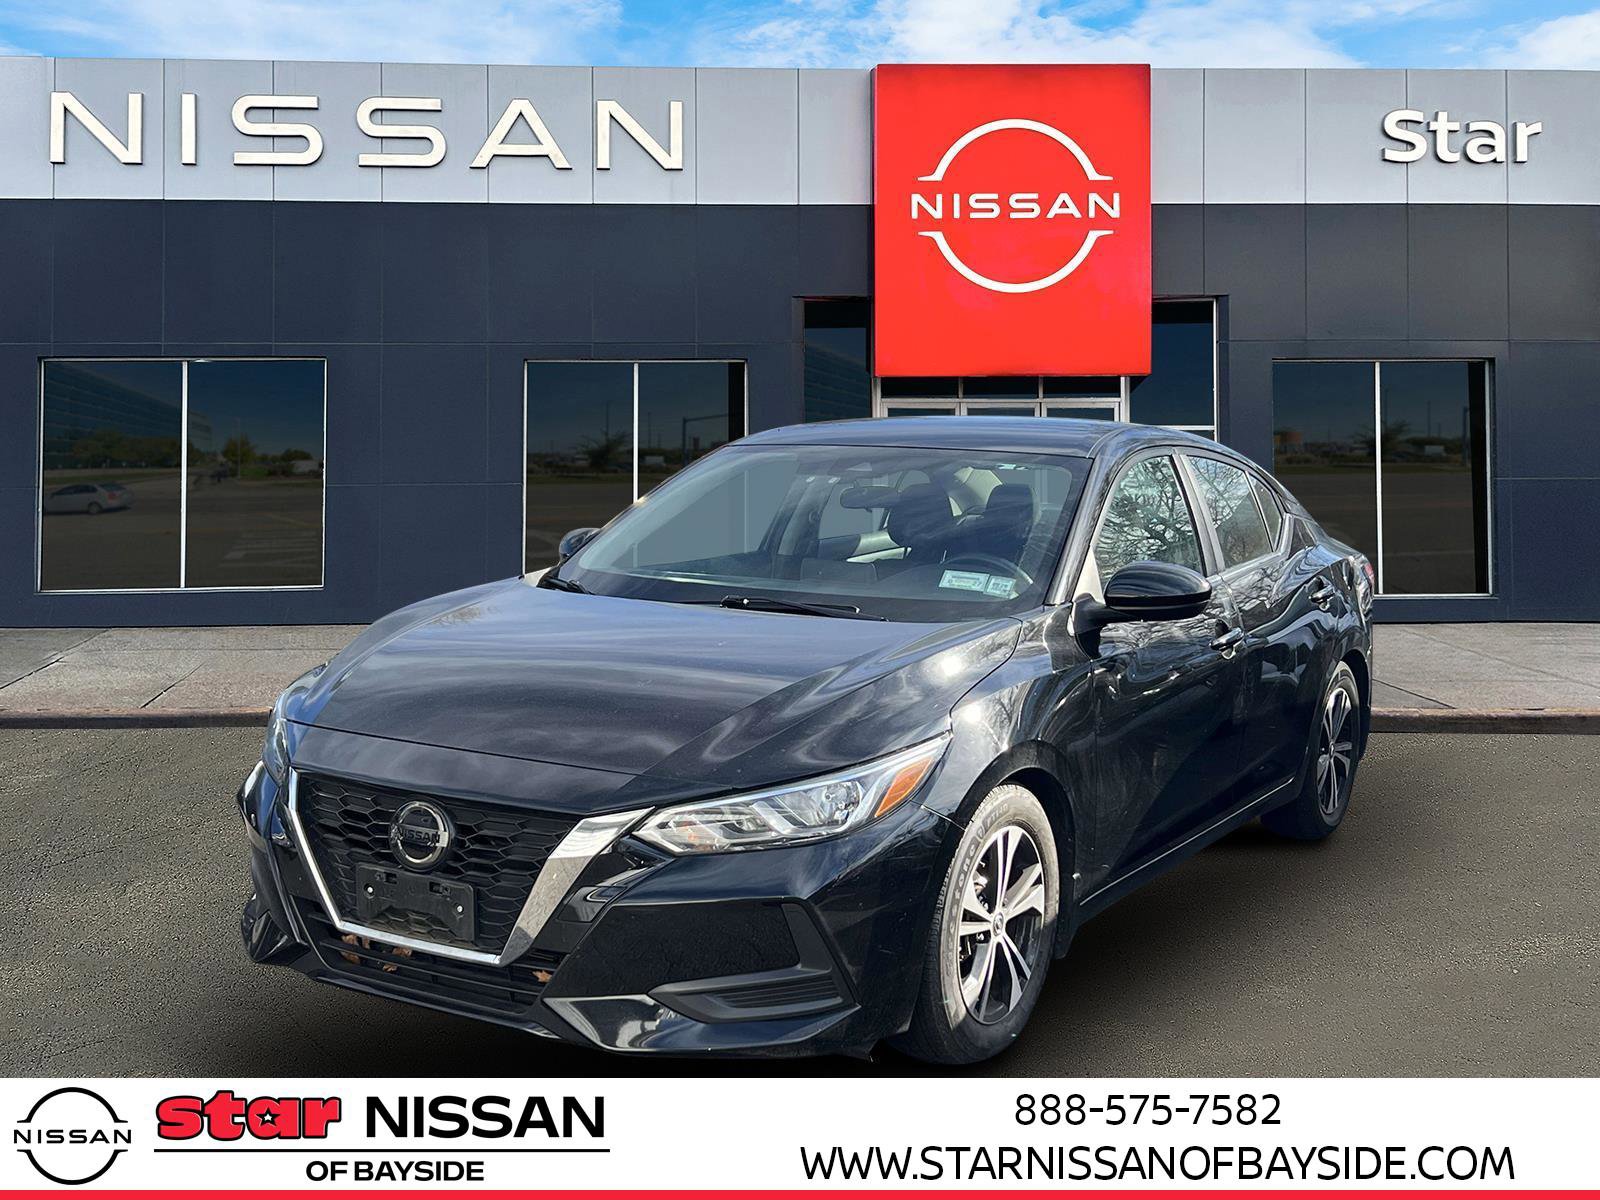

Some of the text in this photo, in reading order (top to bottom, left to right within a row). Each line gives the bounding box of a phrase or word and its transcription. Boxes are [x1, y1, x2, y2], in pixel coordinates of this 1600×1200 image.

[50, 91, 684, 171] NISSAN
[1381, 108, 1543, 164] Star
[911, 192, 1121, 220] NISSAN
